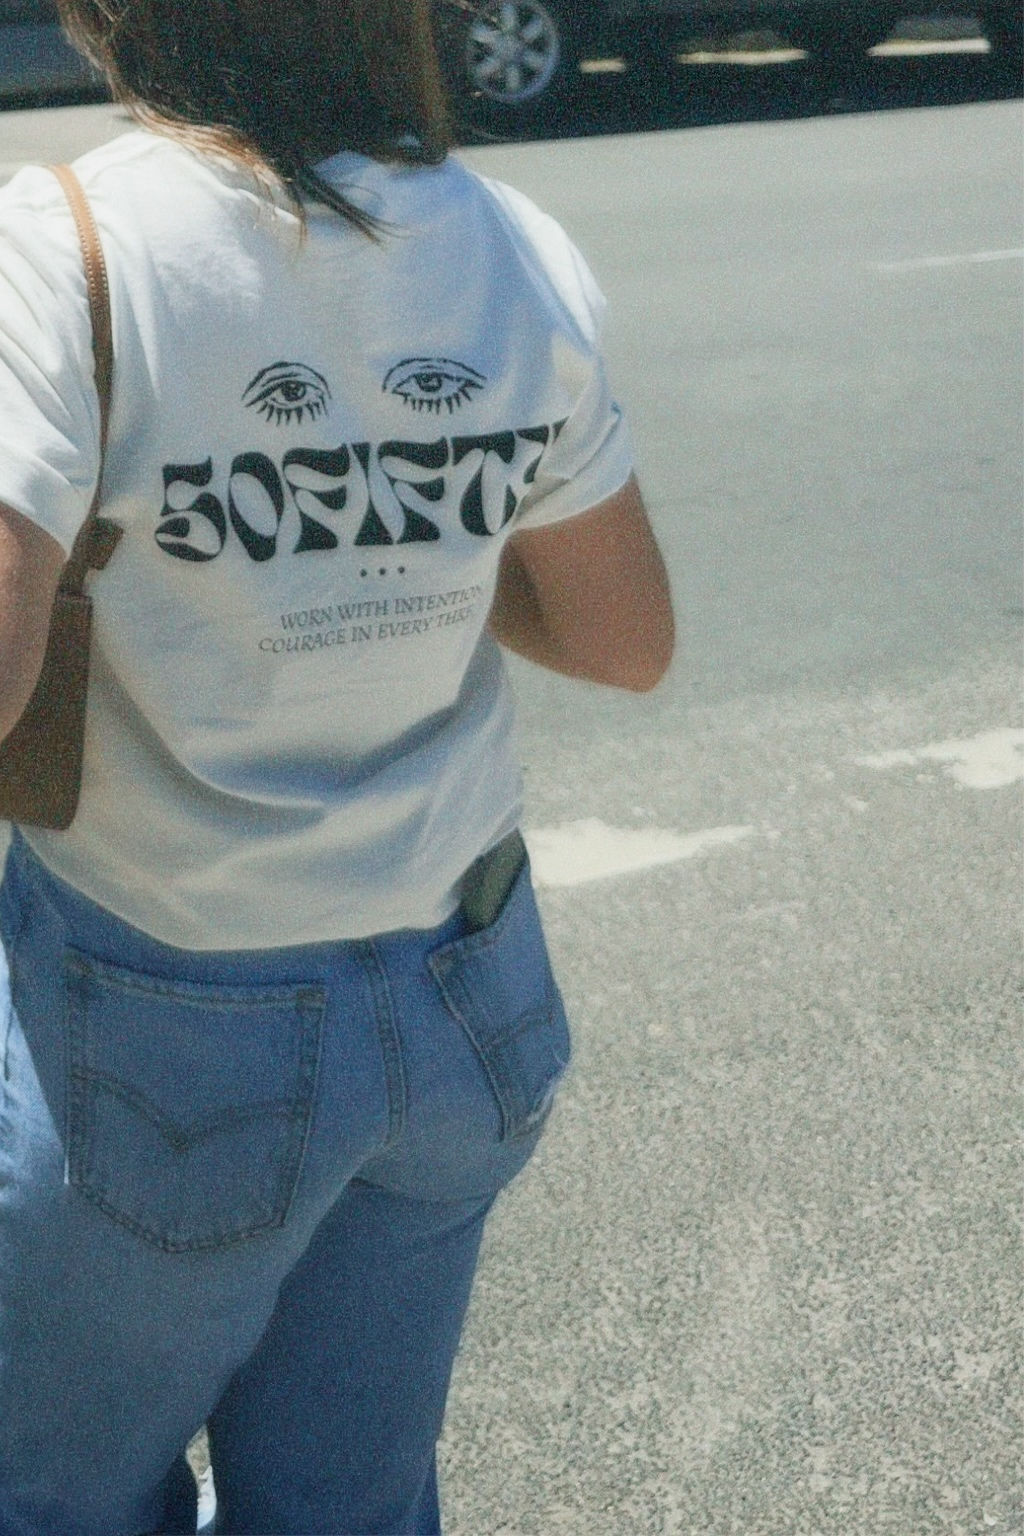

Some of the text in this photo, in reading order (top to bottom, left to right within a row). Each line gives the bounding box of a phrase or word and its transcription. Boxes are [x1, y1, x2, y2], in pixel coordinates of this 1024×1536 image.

[280, 605, 333, 630] WORN
[337, 599, 388, 621] WITH
[258, 628, 346, 654] COURAGE
[351, 625, 372, 642] IN
[376, 617, 433, 640] EVERY
